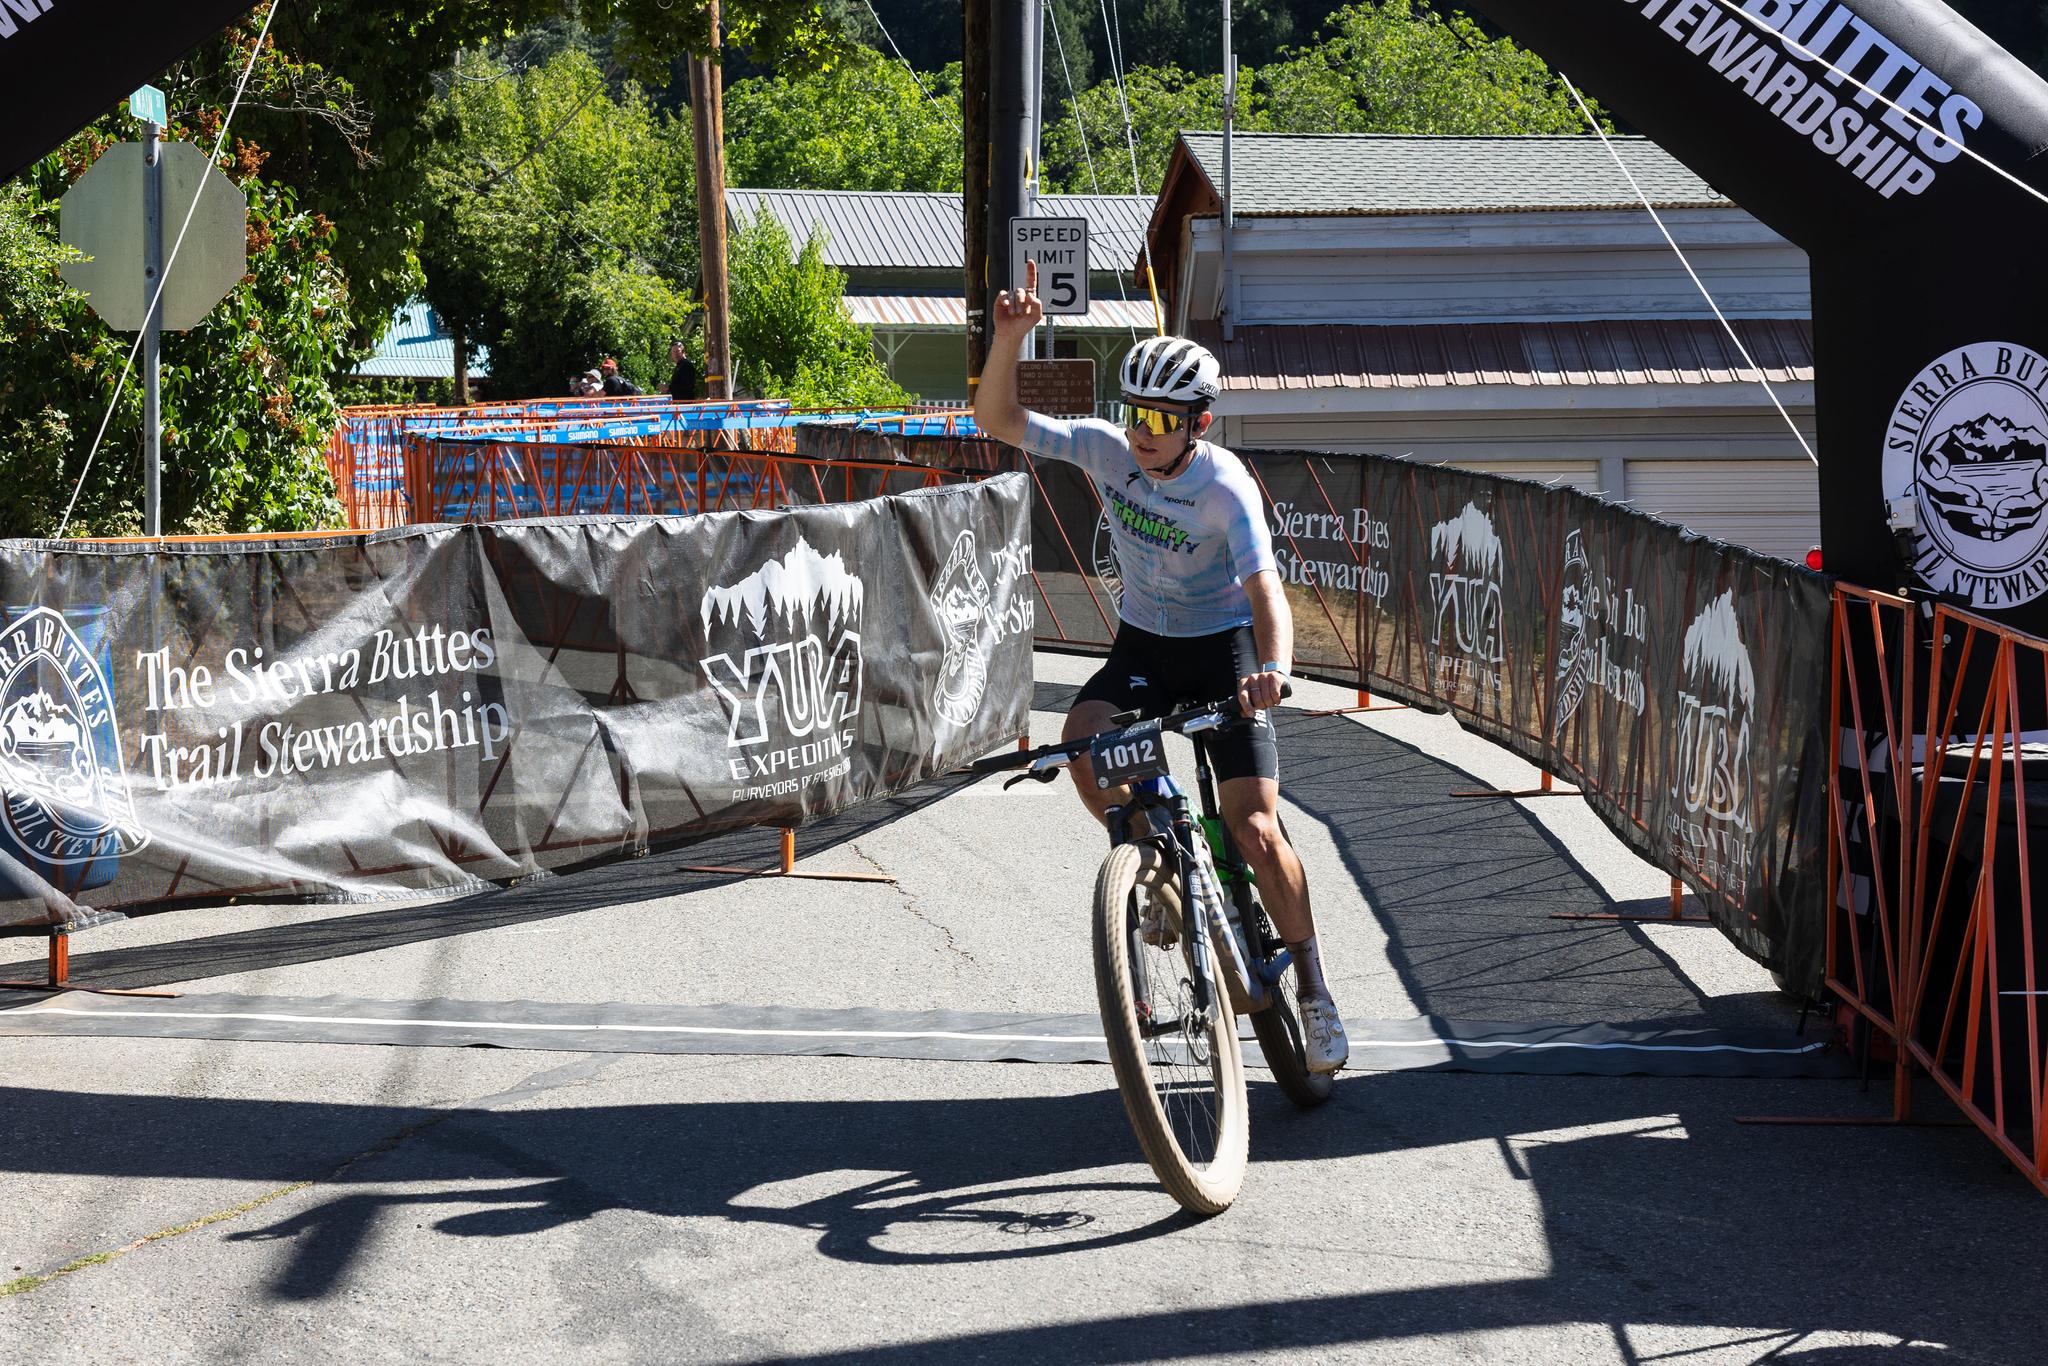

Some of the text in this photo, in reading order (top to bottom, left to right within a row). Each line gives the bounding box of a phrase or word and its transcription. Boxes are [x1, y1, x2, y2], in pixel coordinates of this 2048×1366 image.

[1623, 0, 1936, 199] EWARDSHIP
[1017, 227, 1081, 242] SPEED
[1024, 250, 1075, 264] LIMIT
[1036, 273, 1077, 307] 5
[1889, 347, 2048, 454] SIERRA BUT
[567, 430, 599, 441] SHIMANO
[608, 426, 639, 437] SHIMANO
[1112, 498, 1189, 547] TRINITY
[1271, 502, 1345, 541] Sierra
[1944, 547, 2048, 605] STEWAR
[43, 617, 110, 729] BUTTES
[136, 624, 495, 711] The Sierra Buttes
[141, 691, 510, 791] Trail Stewardship
[1100, 739, 1157, 770] 1012
[732, 778, 798, 803] PURVEYORS
